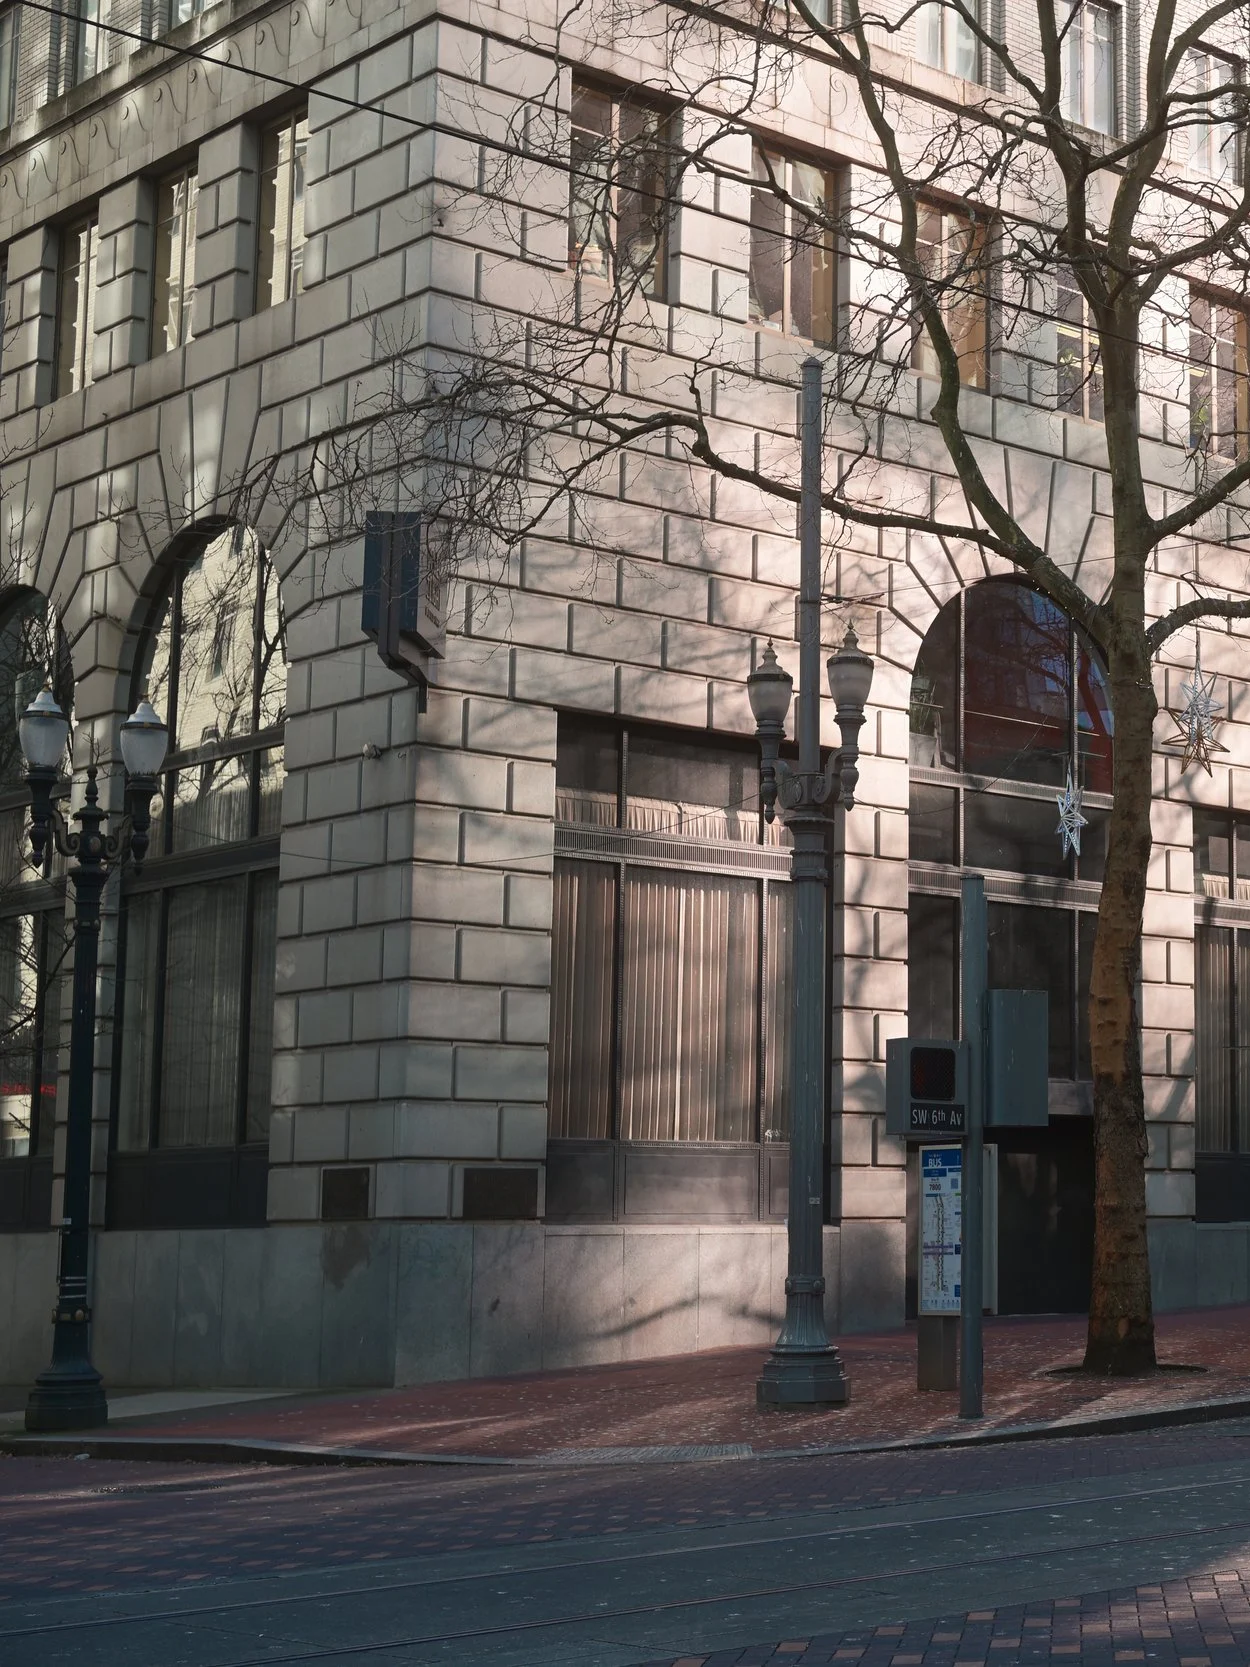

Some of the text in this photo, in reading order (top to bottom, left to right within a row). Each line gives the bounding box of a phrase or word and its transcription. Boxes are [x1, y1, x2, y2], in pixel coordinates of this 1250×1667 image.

[912, 1109, 927, 1124] SW
[932, 1110, 946, 1124] 6th
[928, 1158, 942, 1168] BUS
[929, 1183, 942, 1191] 7800
